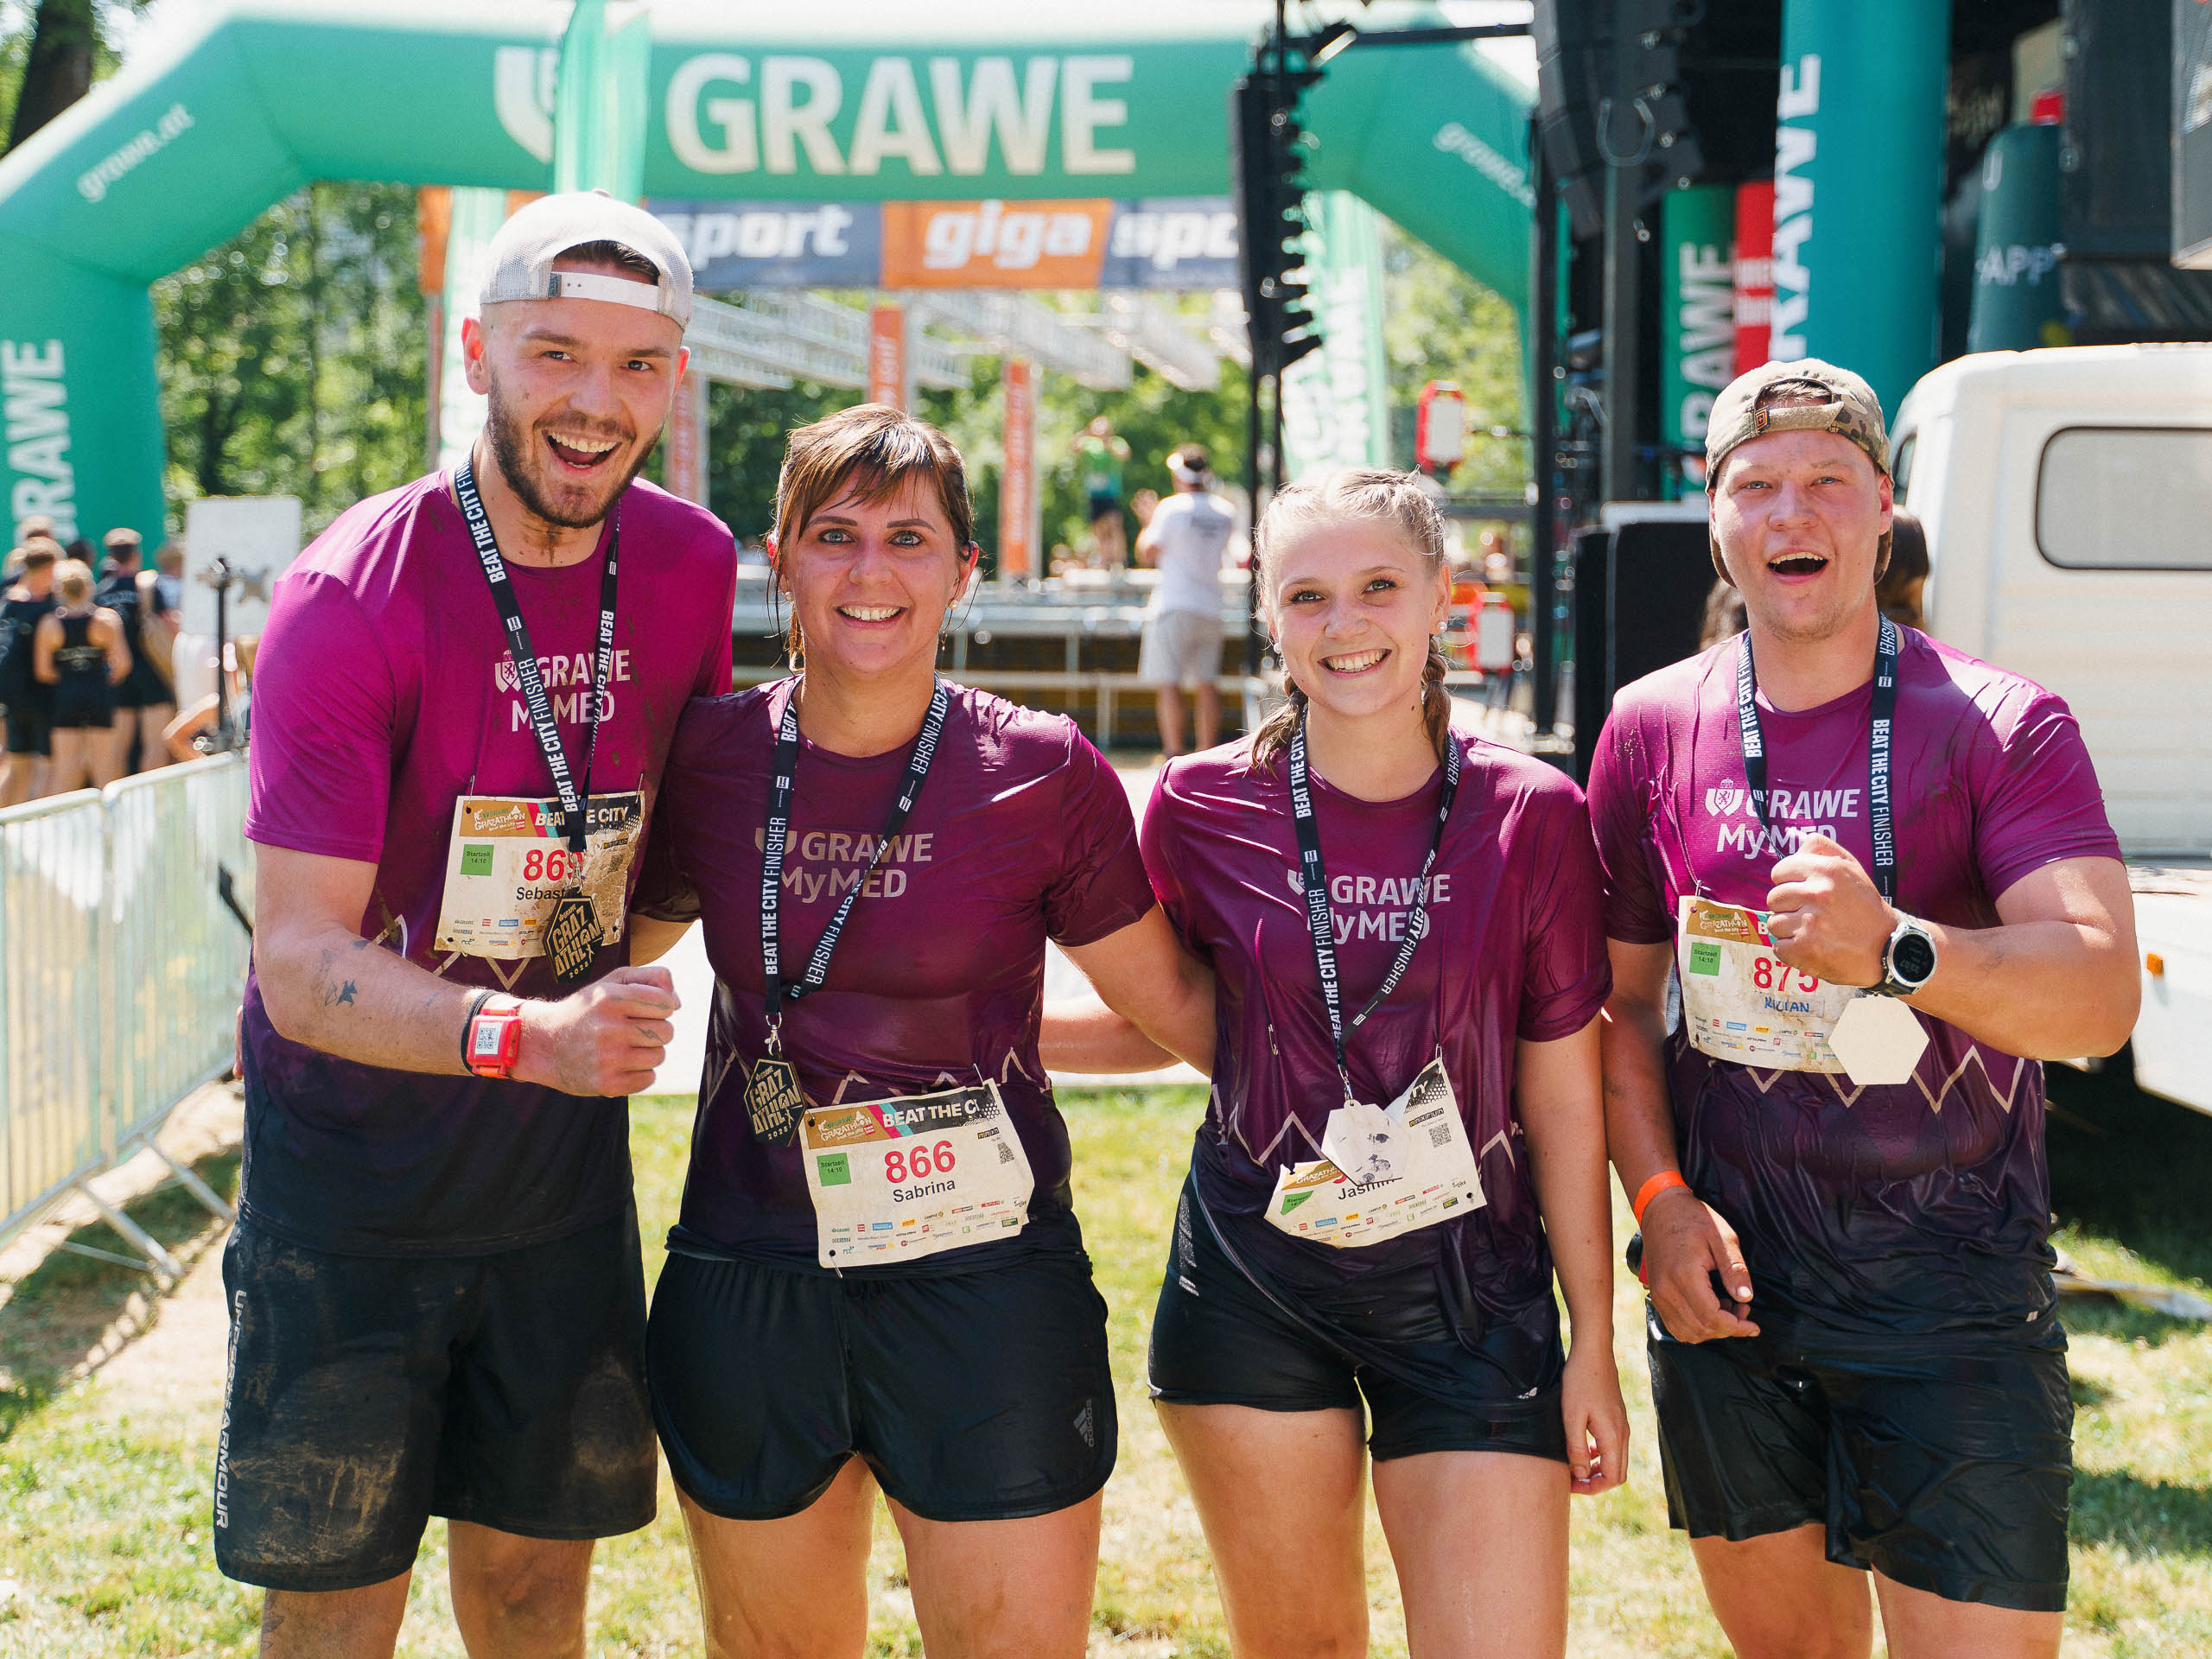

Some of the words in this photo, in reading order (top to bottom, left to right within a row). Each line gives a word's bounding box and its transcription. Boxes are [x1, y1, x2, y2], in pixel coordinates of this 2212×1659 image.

[666, 53, 1137, 176] GRAWE
[78, 102, 194, 203] grawe.at
[924, 200, 1095, 270] giga
[1111, 212, 1238, 270] spo
[460, 489, 484, 520] CITY
[470, 519, 493, 549] THE
[480, 548, 506, 584] BEAT
[600, 610, 614, 649] BEAT
[597, 649, 613, 673] THE
[518, 658, 551, 721] FINISHER
[594, 674, 607, 708] CITY
[1738, 676, 1752, 706] CITY
[512, 692, 615, 734] MMED
[929, 693, 948, 722] CITY
[1740, 704, 1758, 730] THE
[537, 721, 560, 752] CITY
[781, 711, 798, 742] BEAT
[1872, 719, 1890, 751] BEAT
[911, 718, 942, 774] FINISHER
[1290, 734, 1306, 761] CITY
[1743, 729, 1763, 758] BEAT
[548, 750, 569, 779] THE
[1290, 760, 1306, 786] THE
[1447, 734, 1460, 786] NISHER
[1872, 750, 1888, 775] THE
[556, 777, 578, 813] BEAT
[1293, 787, 1313, 819] BEAT
[1871, 775, 1889, 804] CITY
[598, 807, 630, 824] CITY
[764, 817, 787, 876] FINISHER
[802, 833, 934, 862] GRAWE
[1872, 806, 1893, 867] FINISHER
[516, 887, 567, 901] Sebast
[761, 879, 779, 911] CITY
[781, 865, 906, 904] MyMED
[761, 912, 777, 940] THE
[833, 895, 854, 925] CITY
[1308, 888, 1333, 947] FINISHER
[1409, 907, 1425, 940] CITY
[553, 906, 588, 954] GRAZ
[763, 942, 778, 975] BEAT
[805, 925, 840, 985] FINISHER
[1317, 949, 1337, 979] CITY
[1382, 937, 1417, 995] FINISHER
[1694, 949, 1718, 957] Startzeit
[1323, 981, 1339, 1005] THE
[1329, 1007, 1342, 1040] BEAT
[749, 1068, 786, 1112] GRAZ
[882, 1107, 927, 1128] BEAT
[927, 1103, 963, 1119] THE
[884, 1140, 956, 1184] 866
[893, 1180, 956, 1203] Sabrina
[216, 1408, 232, 1529] ARMOUR
